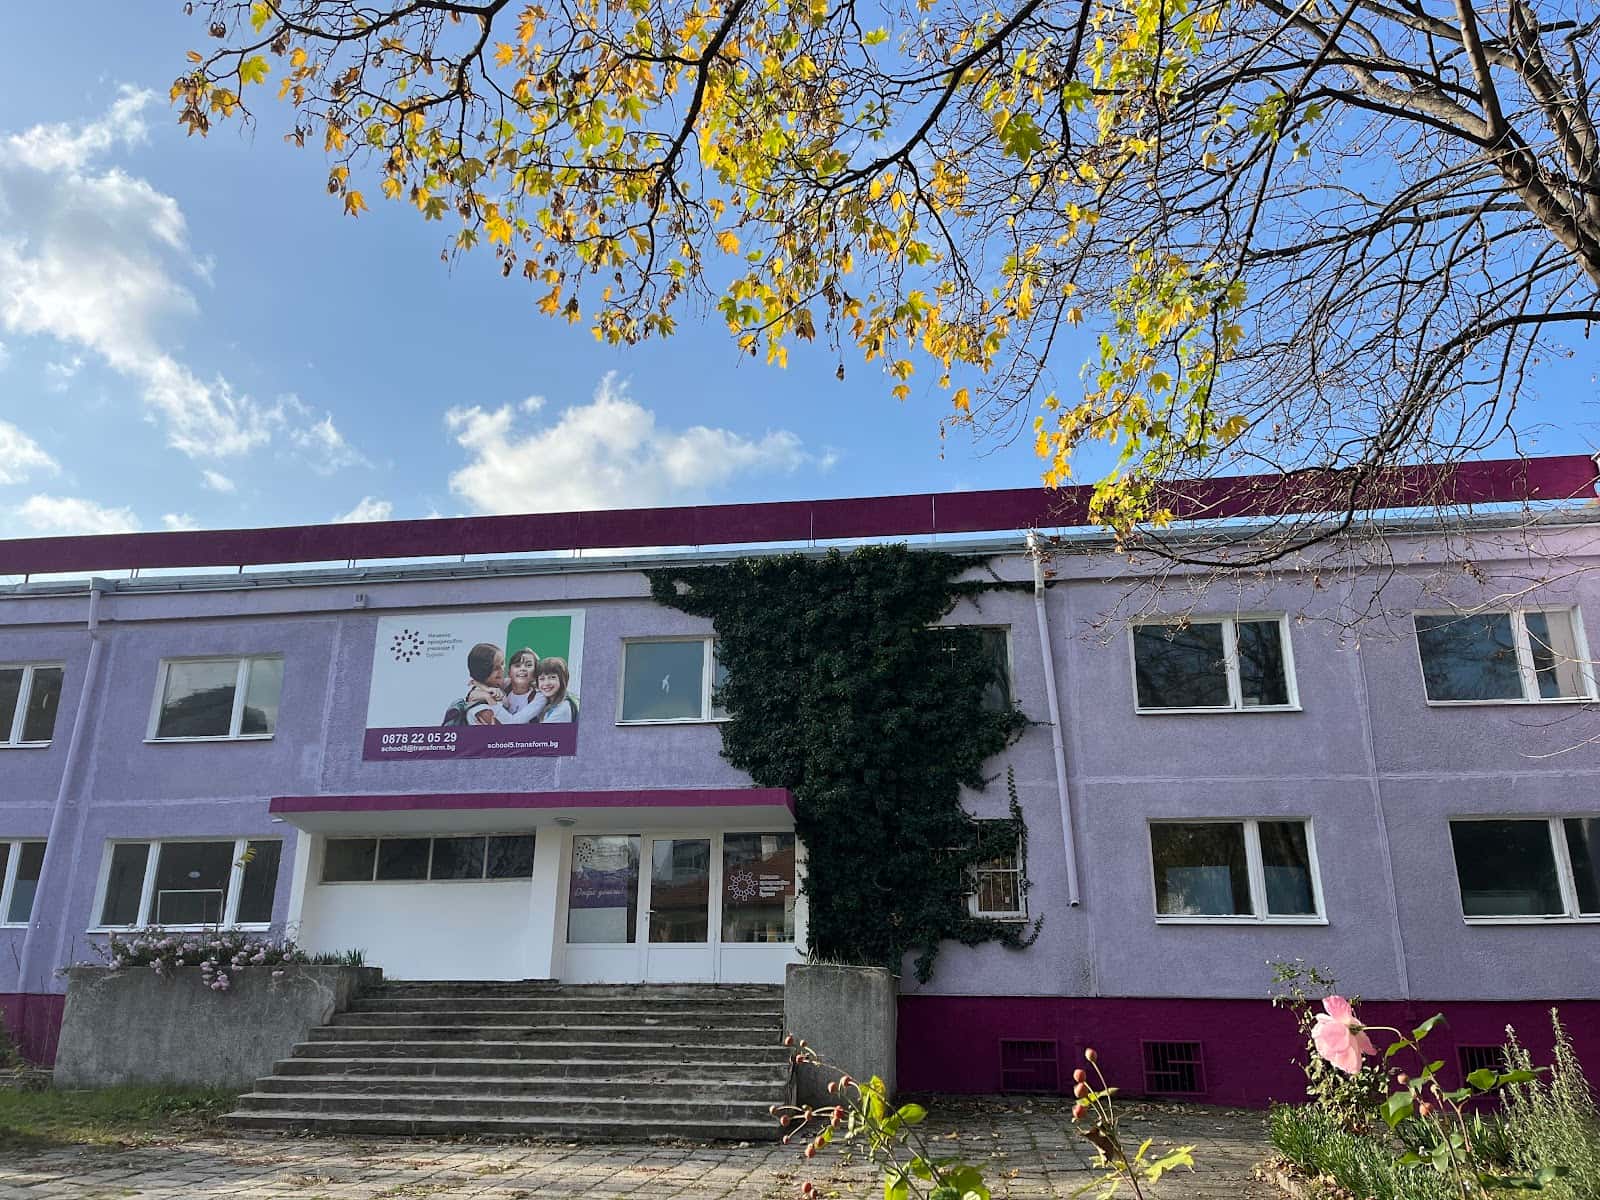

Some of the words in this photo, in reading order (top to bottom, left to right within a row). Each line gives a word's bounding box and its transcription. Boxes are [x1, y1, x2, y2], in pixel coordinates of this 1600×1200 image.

[382, 734, 408, 744] 0878
[411, 733, 424, 743] 22
[427, 732, 441, 743] 05
[444, 732, 457, 742] 29
[487, 741, 559, 749] school5.transform.bg
